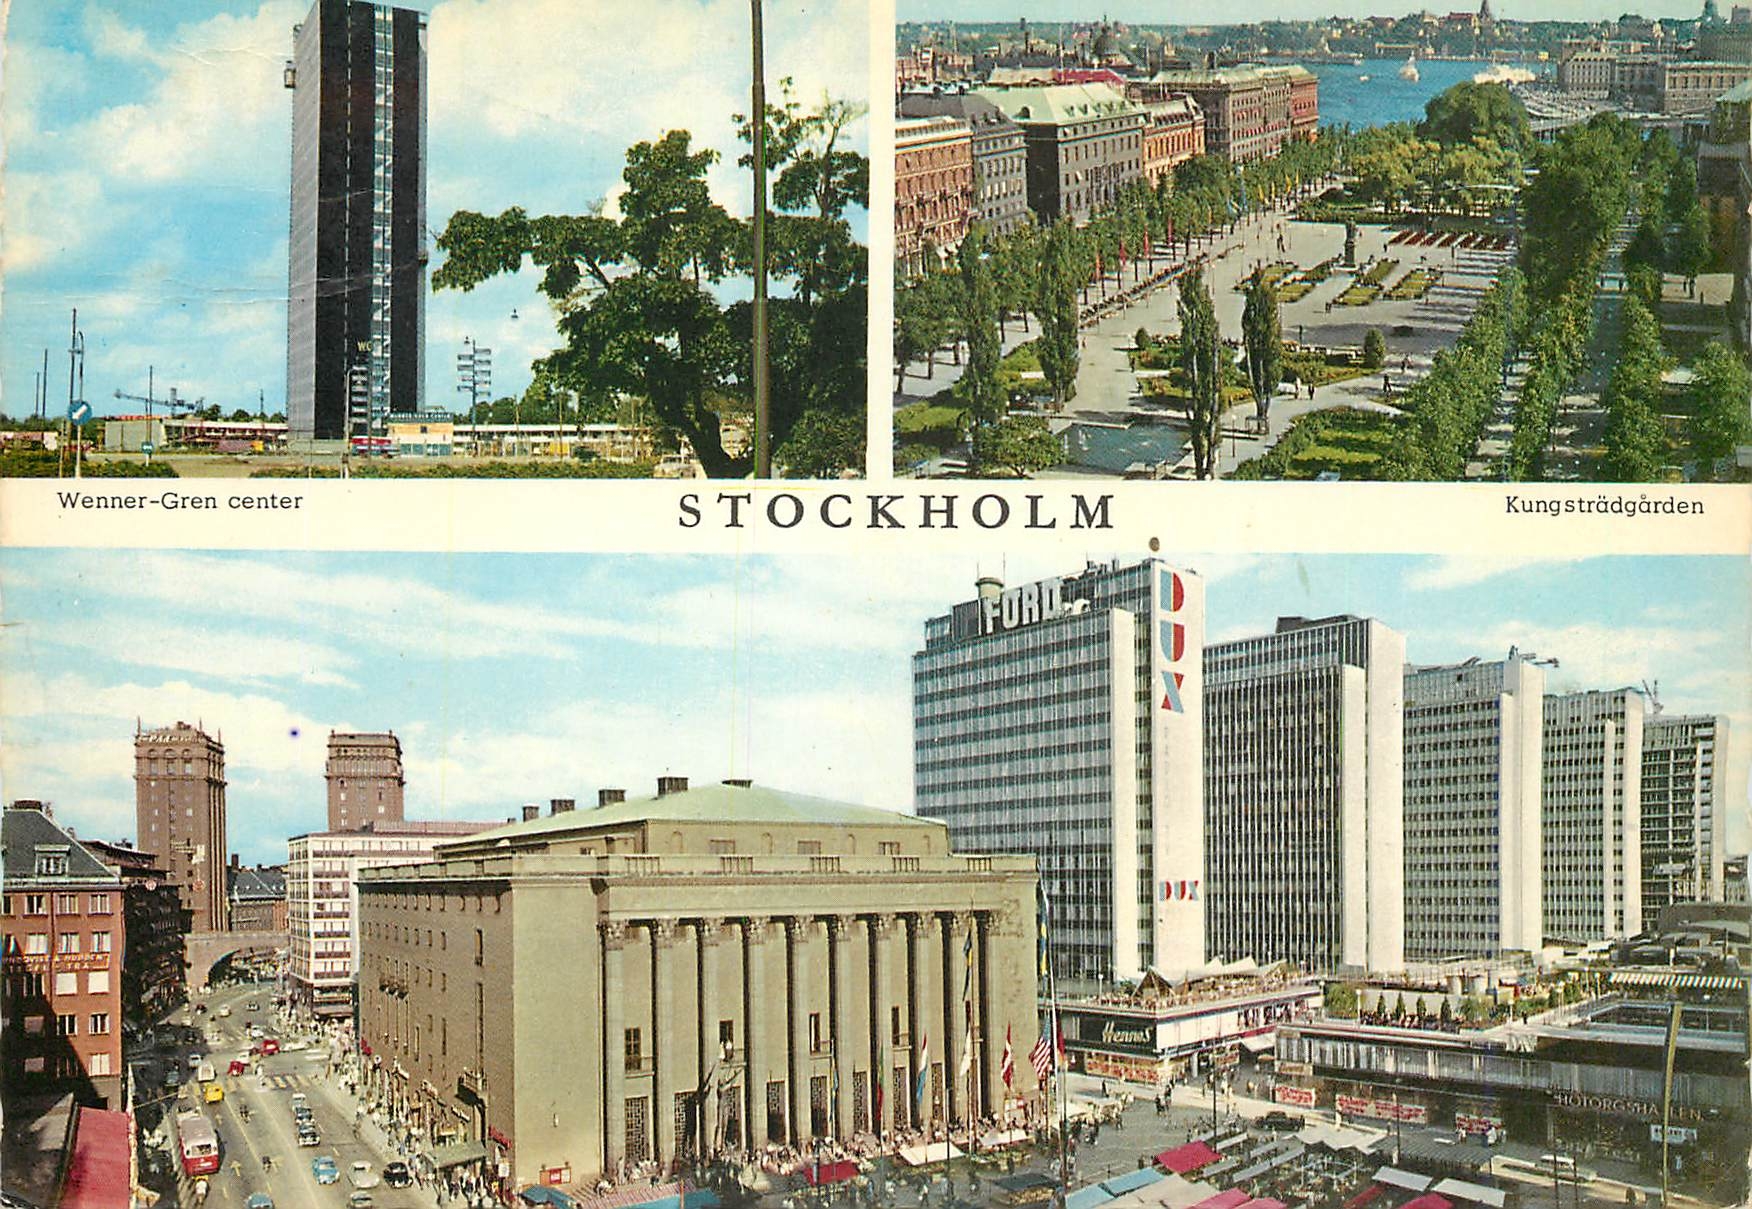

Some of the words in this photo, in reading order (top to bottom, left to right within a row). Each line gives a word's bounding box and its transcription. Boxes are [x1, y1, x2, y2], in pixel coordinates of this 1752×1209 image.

[981, 577, 1062, 635] FORD
[1159, 568, 1185, 714] DUX
[1158, 880, 1200, 902] DUX
